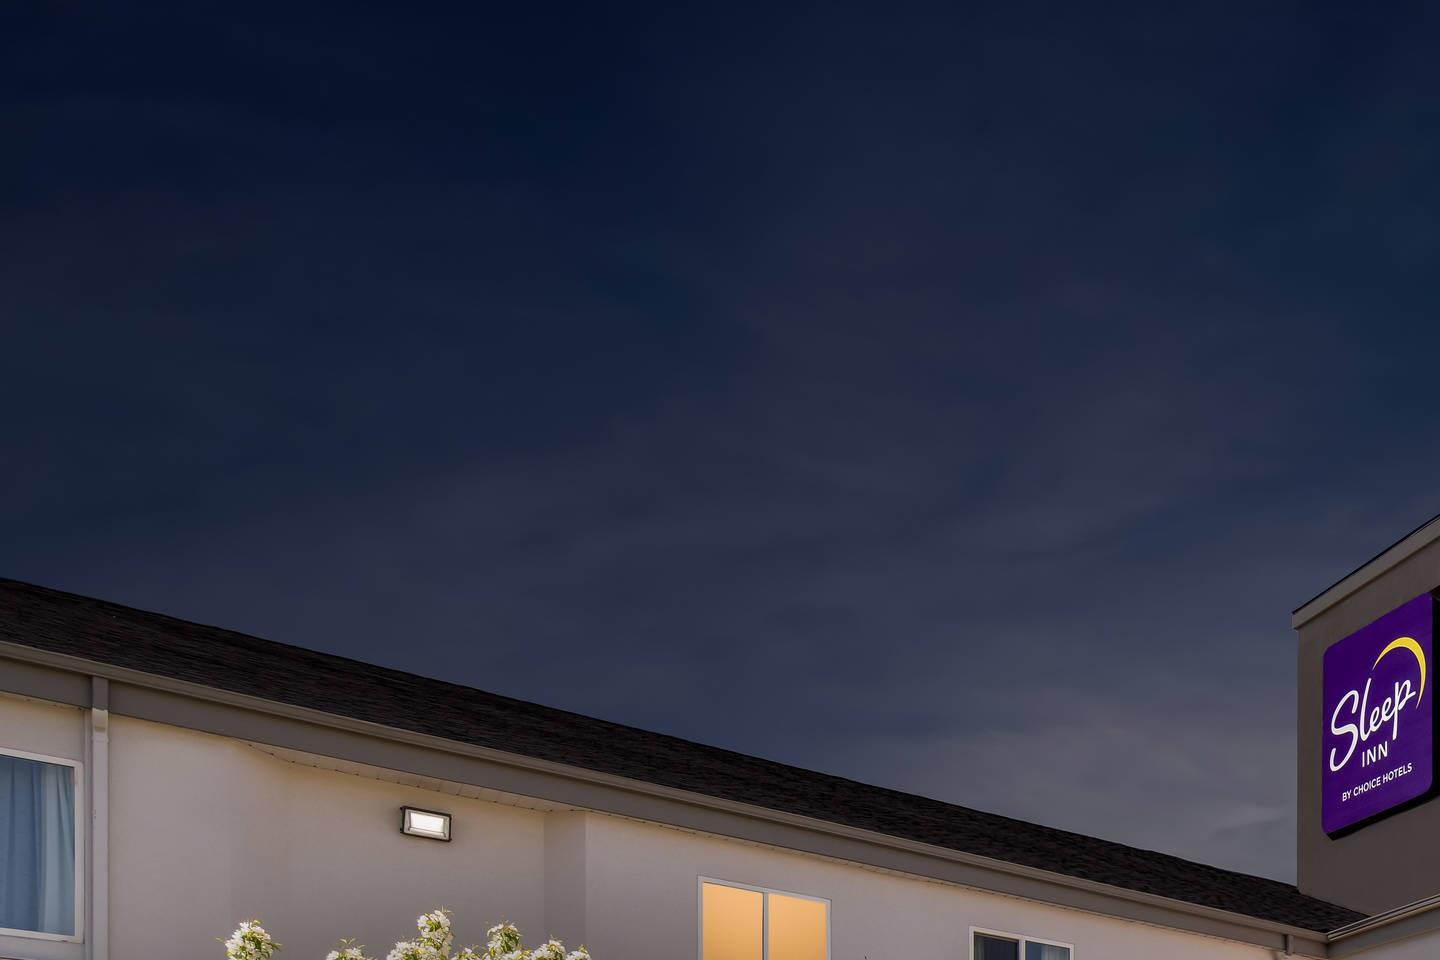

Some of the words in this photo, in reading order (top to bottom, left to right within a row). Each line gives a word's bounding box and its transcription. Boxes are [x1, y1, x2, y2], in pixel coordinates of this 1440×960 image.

[1329, 678, 1417, 772] Sleep
[1362, 741, 1388, 768] INN
[1342, 790, 1352, 802] BY
[1353, 776, 1381, 797] CHOICE
[1382, 762, 1413, 784] HOTELS
